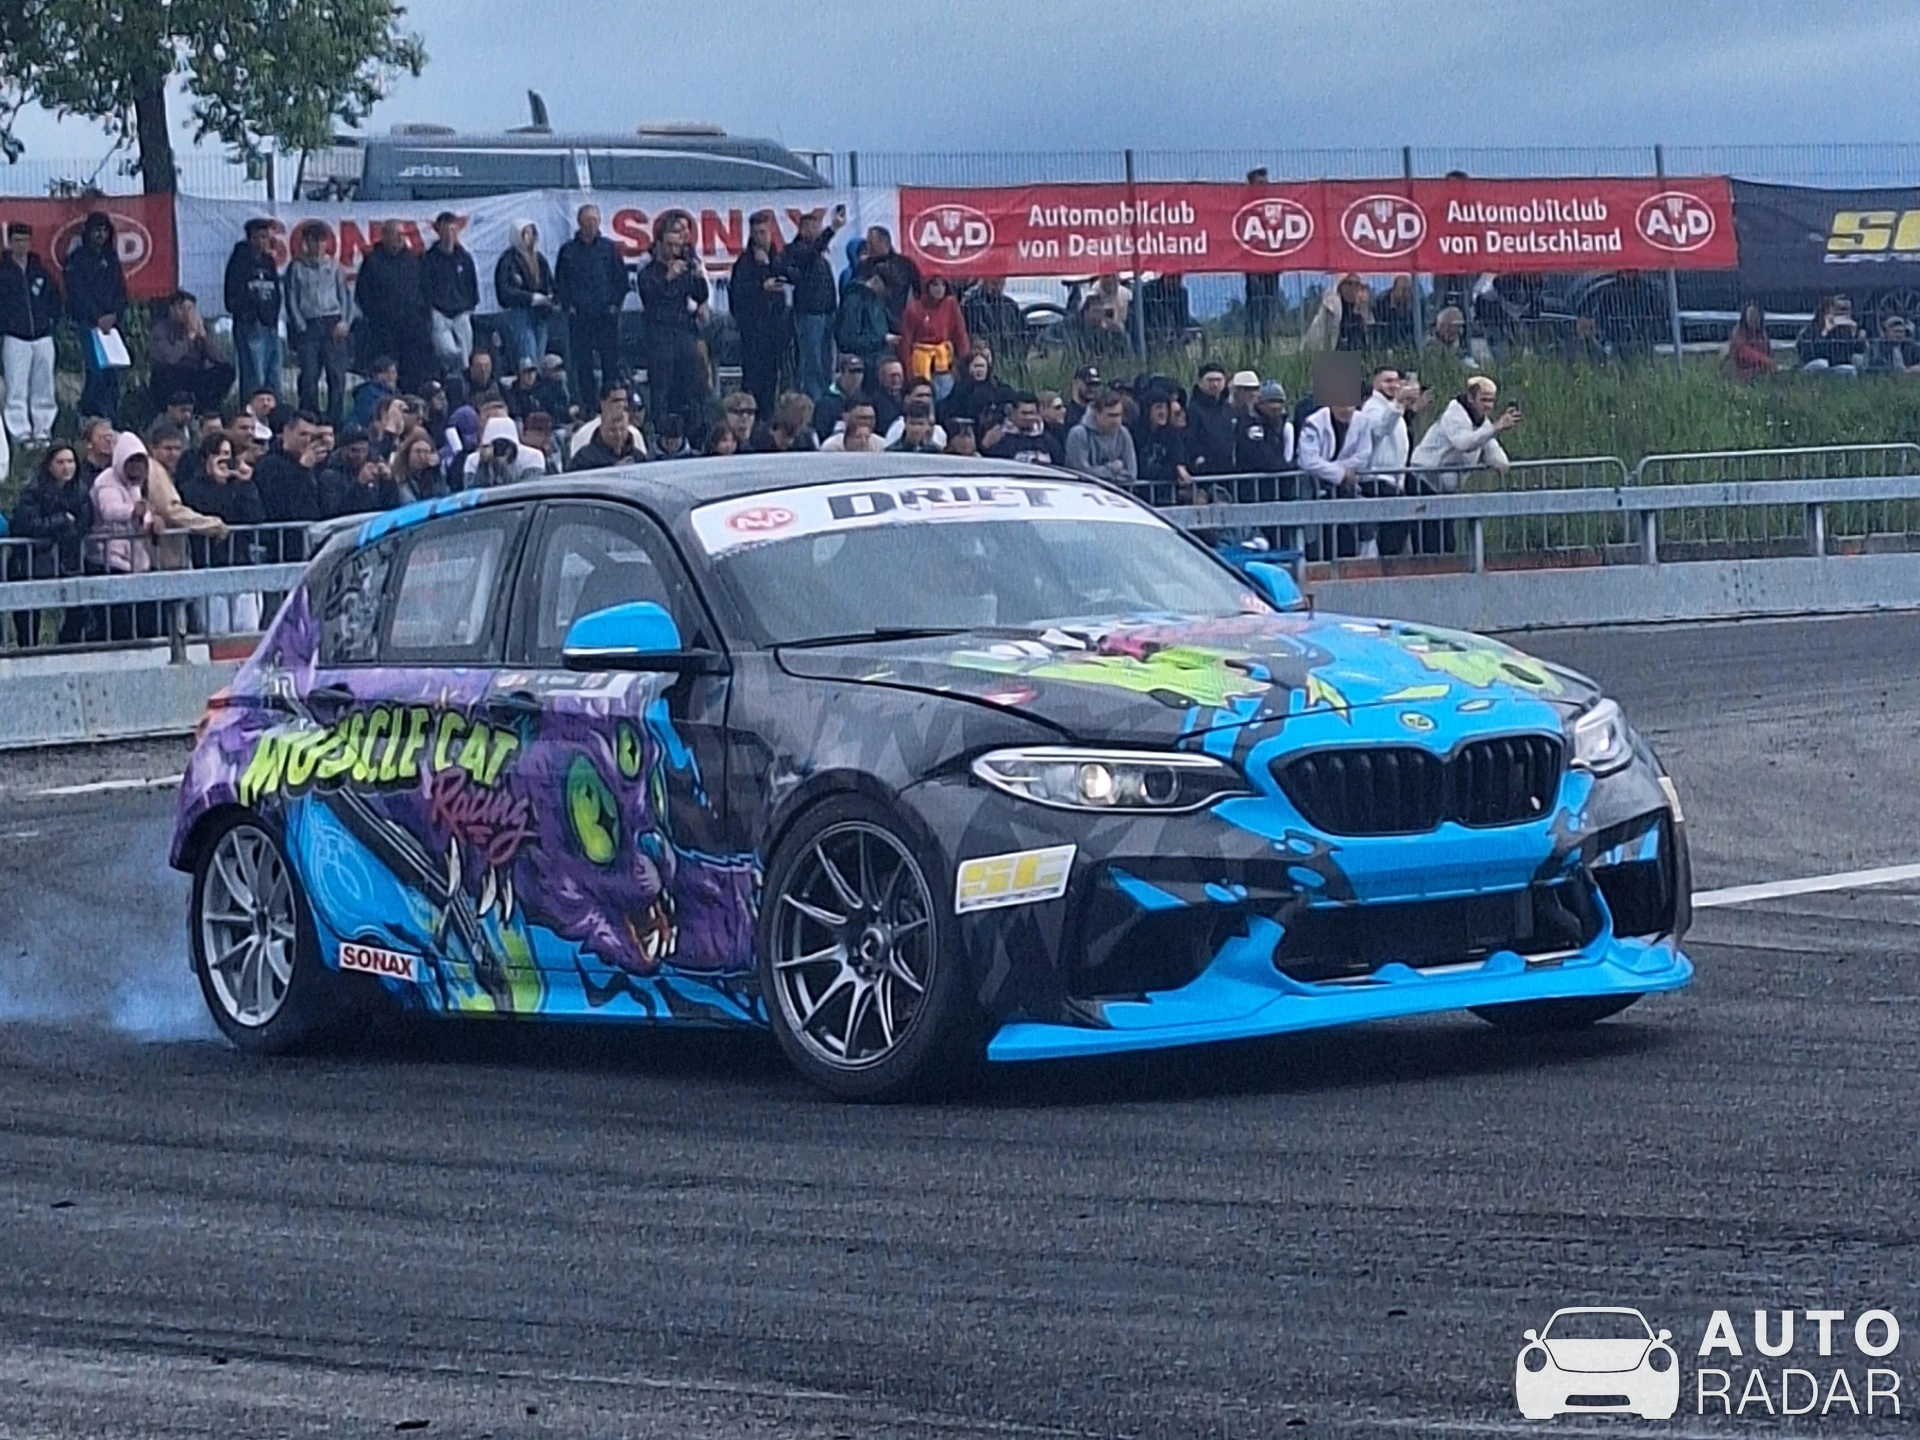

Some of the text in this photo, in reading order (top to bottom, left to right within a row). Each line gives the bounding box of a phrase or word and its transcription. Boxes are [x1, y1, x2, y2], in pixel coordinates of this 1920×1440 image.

[1028, 199, 1195, 227] Automobilclub
[1447, 196, 1608, 223] Automobilclub
[1018, 229, 1208, 259] von Deutschland
[1438, 227, 1623, 254] von Deutschland
[827, 485, 1060, 521] DRIFT
[239, 706, 518, 807] MUSCLE CAT
[343, 945, 412, 977] SONAX
